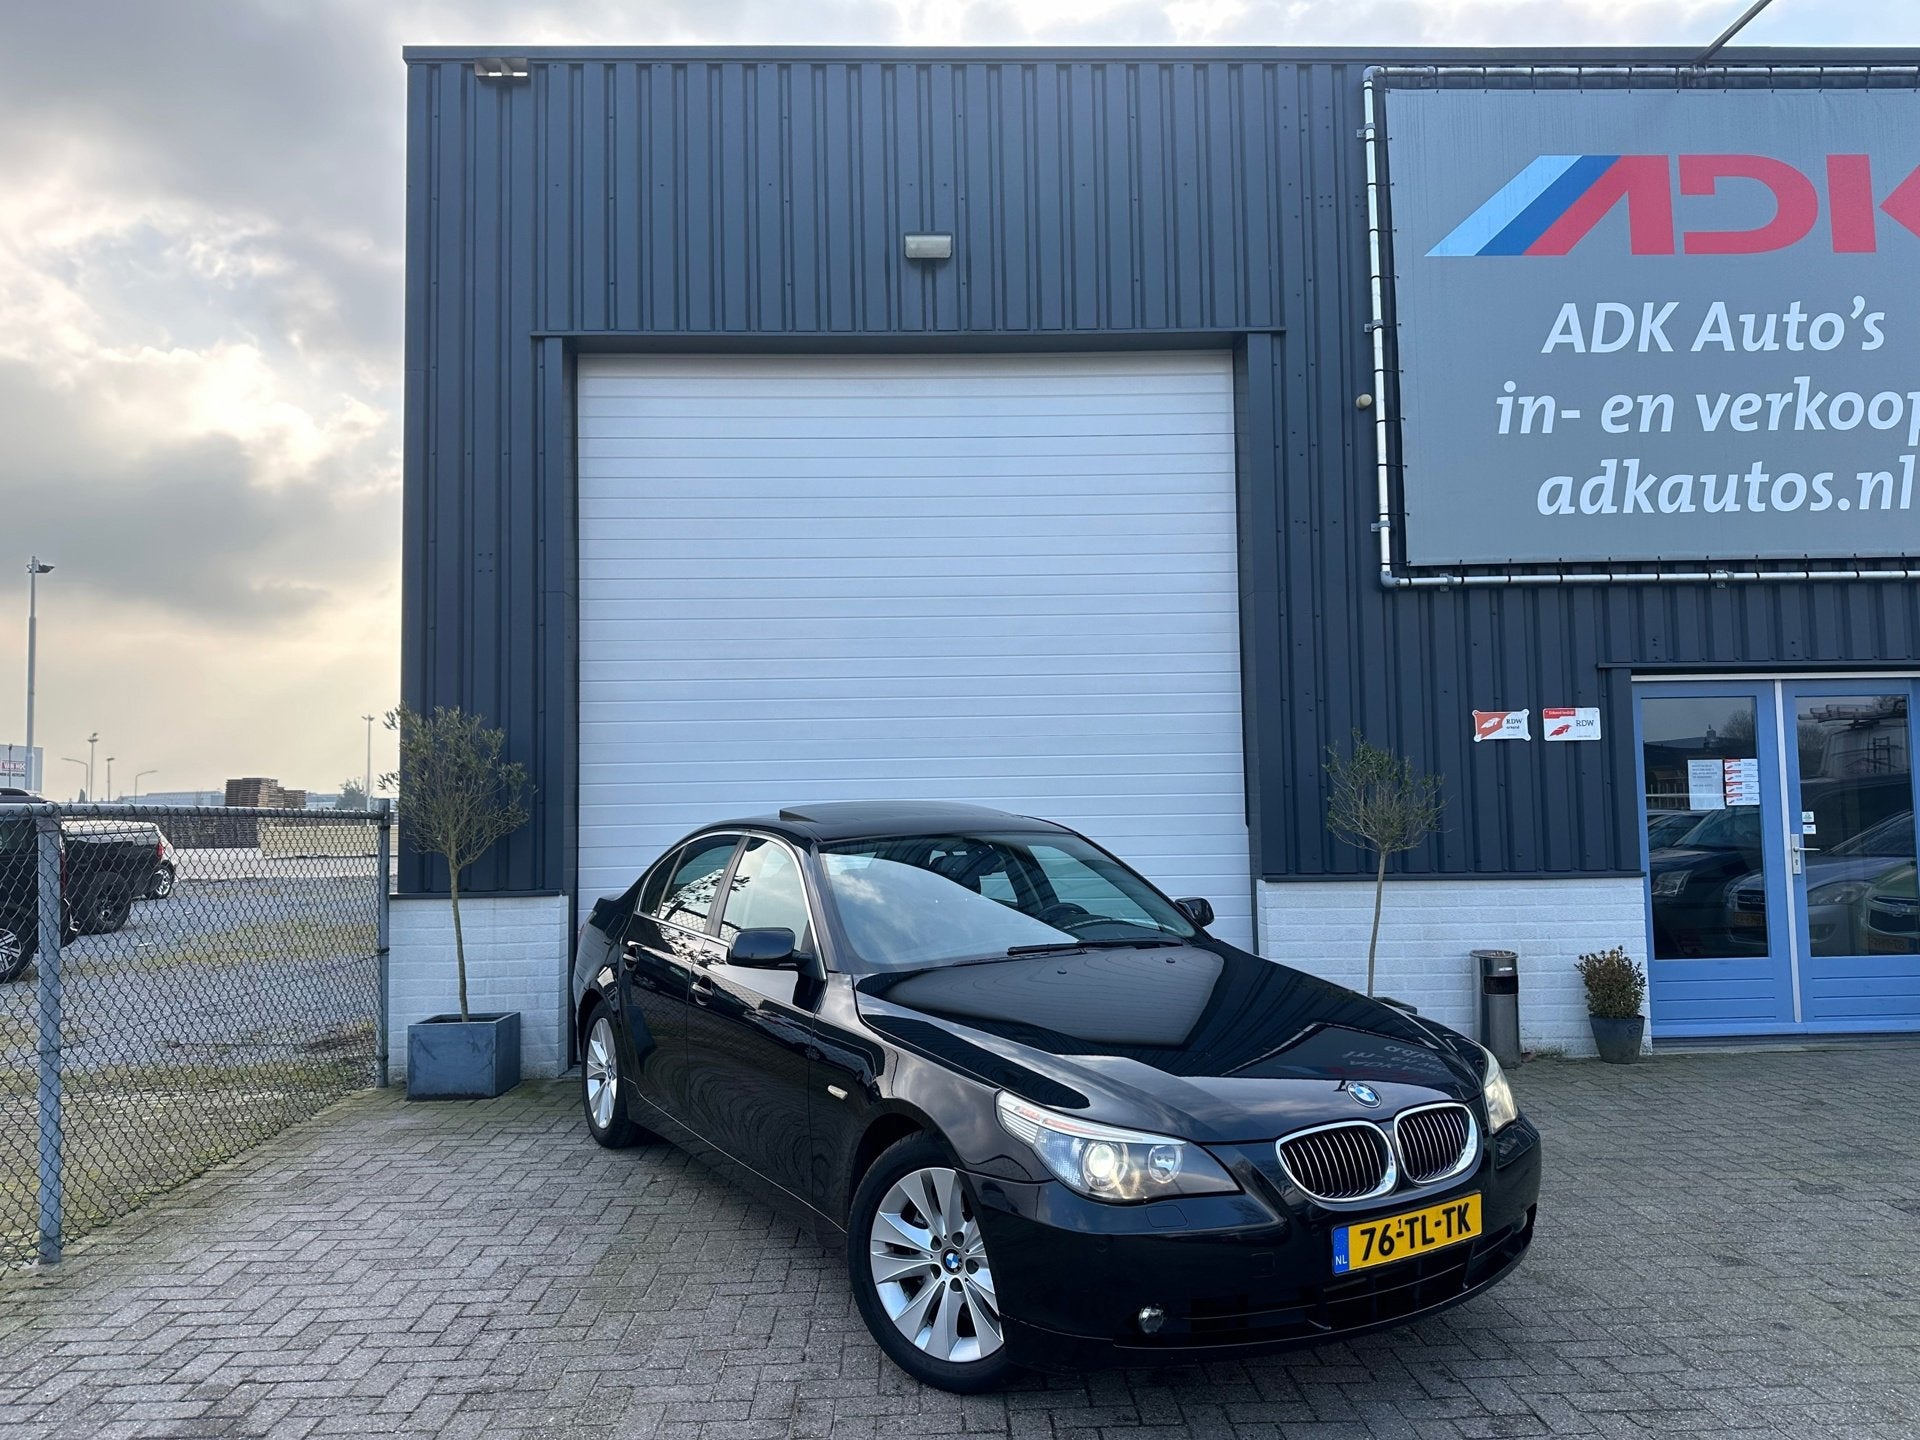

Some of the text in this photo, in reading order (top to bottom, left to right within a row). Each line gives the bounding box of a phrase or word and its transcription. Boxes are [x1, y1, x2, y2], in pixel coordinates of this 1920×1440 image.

[1522, 154, 1920, 256] ADK
[1541, 295, 1886, 354] ADK Auto's
[1496, 381, 1581, 434] in-
[1600, 392, 1675, 434] en
[1536, 455, 1916, 516] adkautos.nl
[1575, 719, 1594, 727] RDW
[1335, 1255, 1348, 1266] NL
[1360, 1202, 1472, 1262] 76-TL-TK
